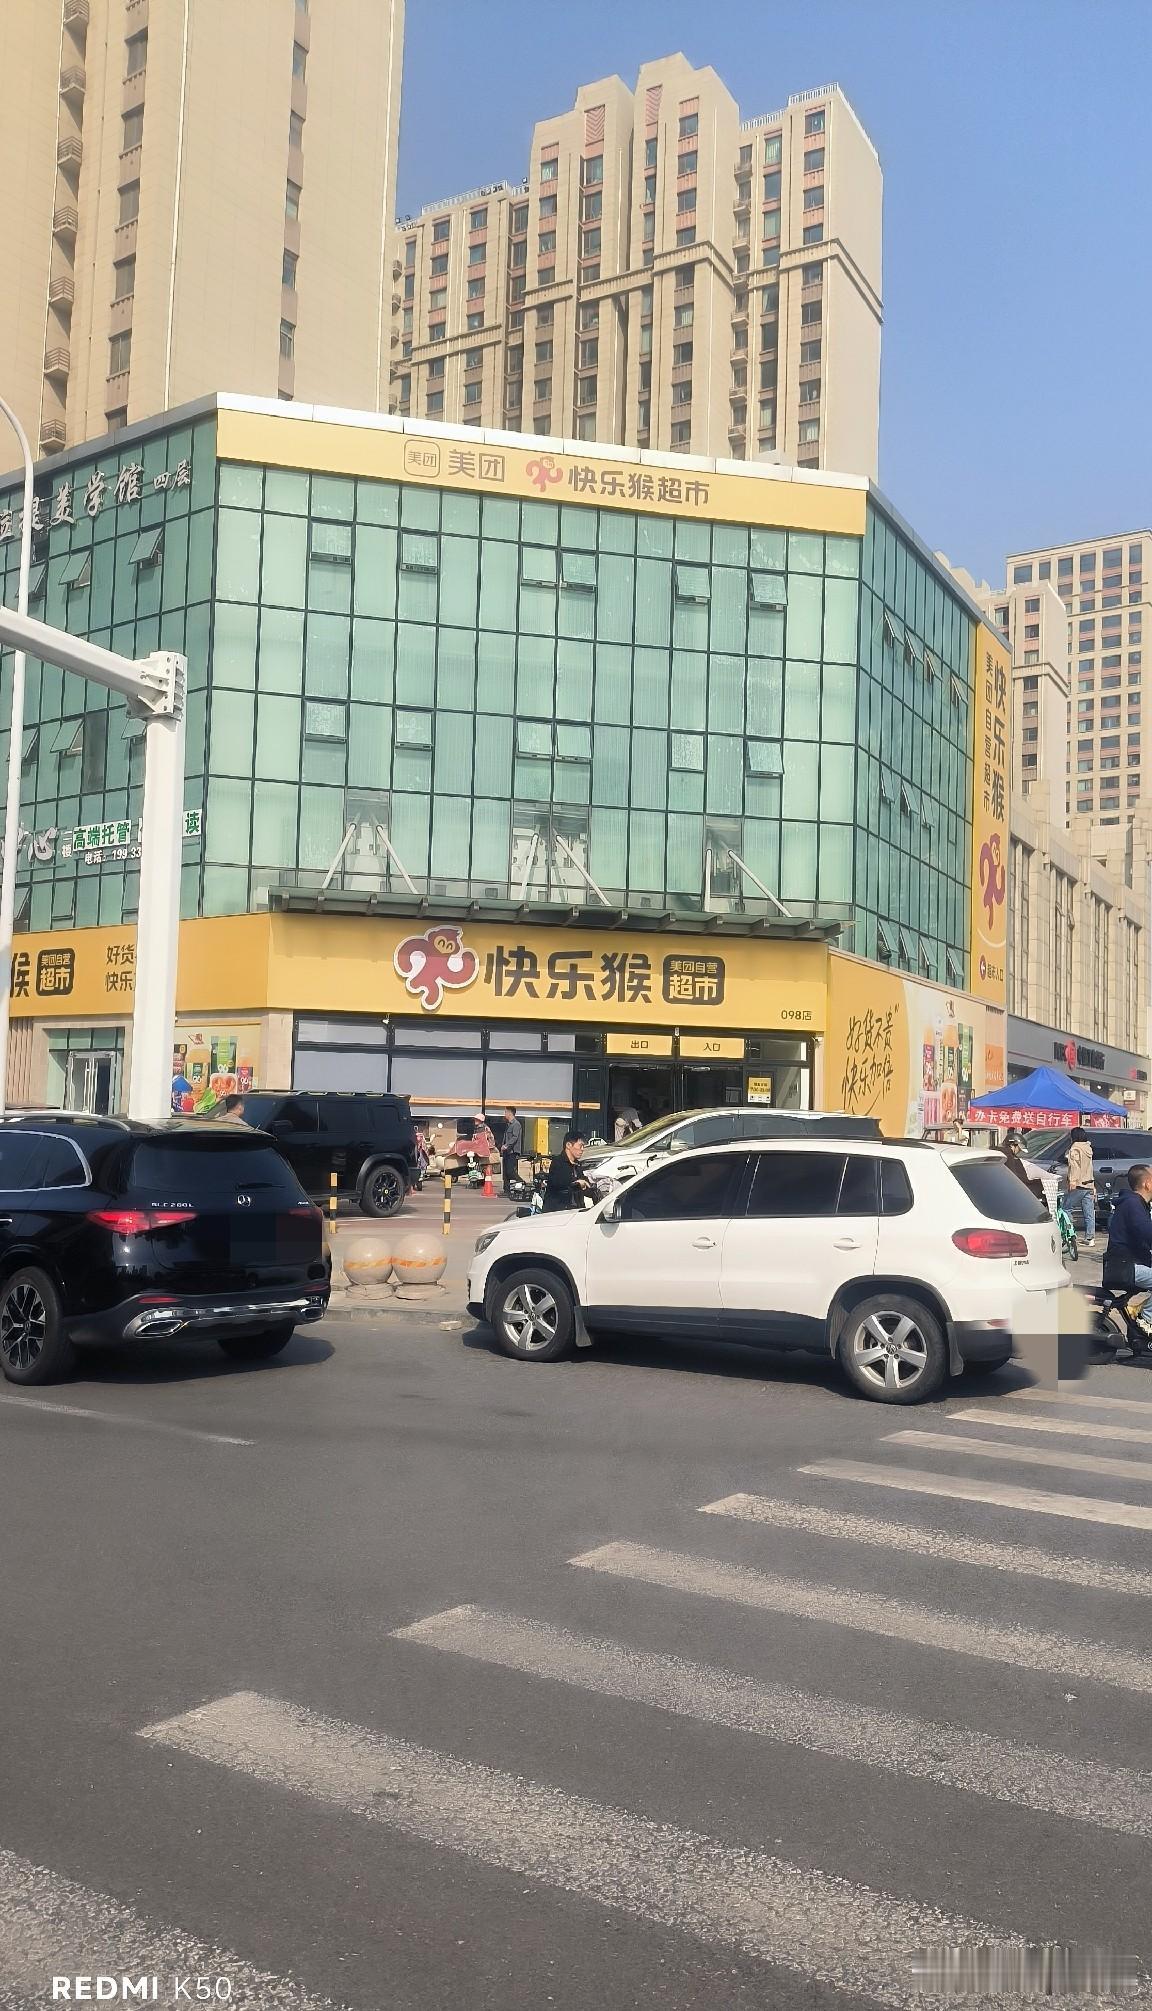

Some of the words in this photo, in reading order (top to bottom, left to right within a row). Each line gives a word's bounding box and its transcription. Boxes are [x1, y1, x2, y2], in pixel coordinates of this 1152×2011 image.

[408, 451, 437, 468] 美团
[448, 449, 505, 483] 美团
[568, 465, 710, 507] 快乐猴超市
[991, 661, 1007, 823] 快乐猴
[73, 822, 130, 850] 高端托管
[40, 967, 71, 992] 超市
[484, 945, 652, 1004] 快乐猴
[669, 960, 718, 974] 美团自营
[668, 974, 719, 1000] 超市
[781, 1010, 812, 1021] 098店
[630, 1040, 649, 1049] 出口
[703, 1042, 721, 1052] 入口
[975, 1110, 1074, 1126] 办卡免费送自行车
